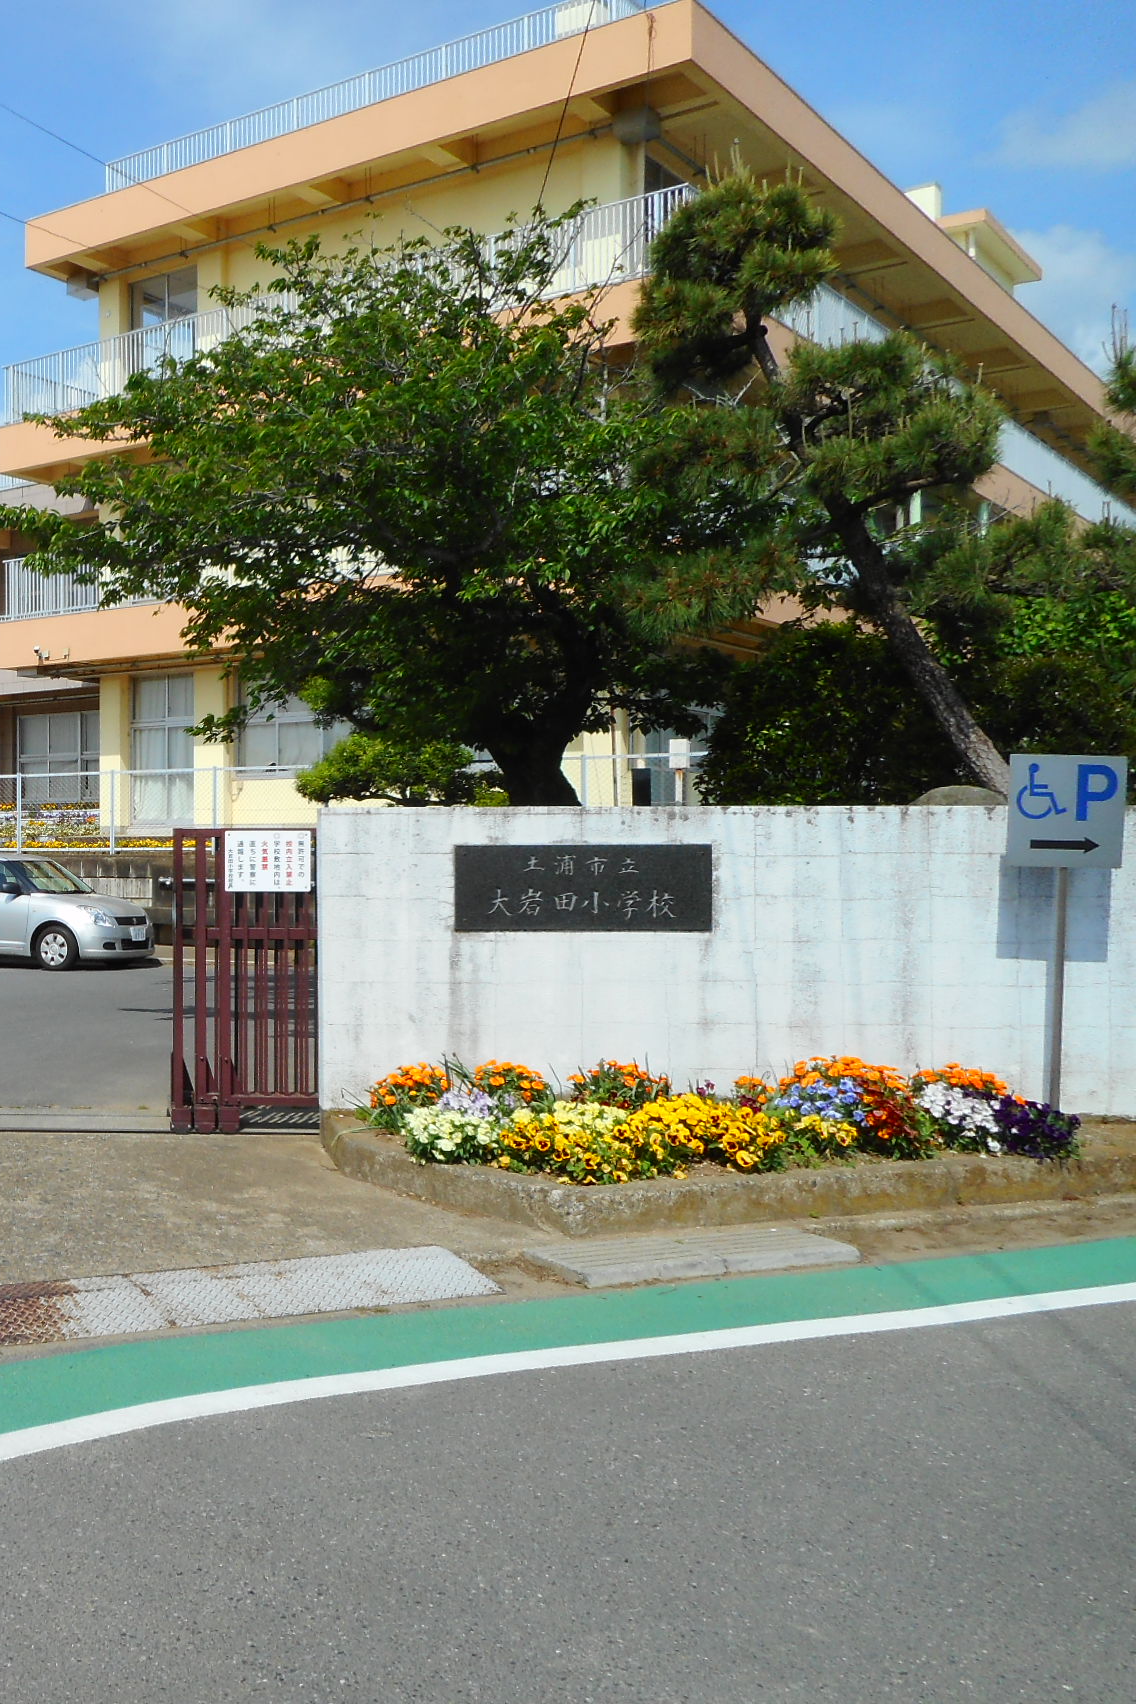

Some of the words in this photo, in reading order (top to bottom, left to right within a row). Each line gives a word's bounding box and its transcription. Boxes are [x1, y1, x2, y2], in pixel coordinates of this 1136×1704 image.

[1075, 764, 1118, 821] P
[523, 855, 640, 876] 土浦市立
[488, 888, 677, 919] 大岩田小学校
